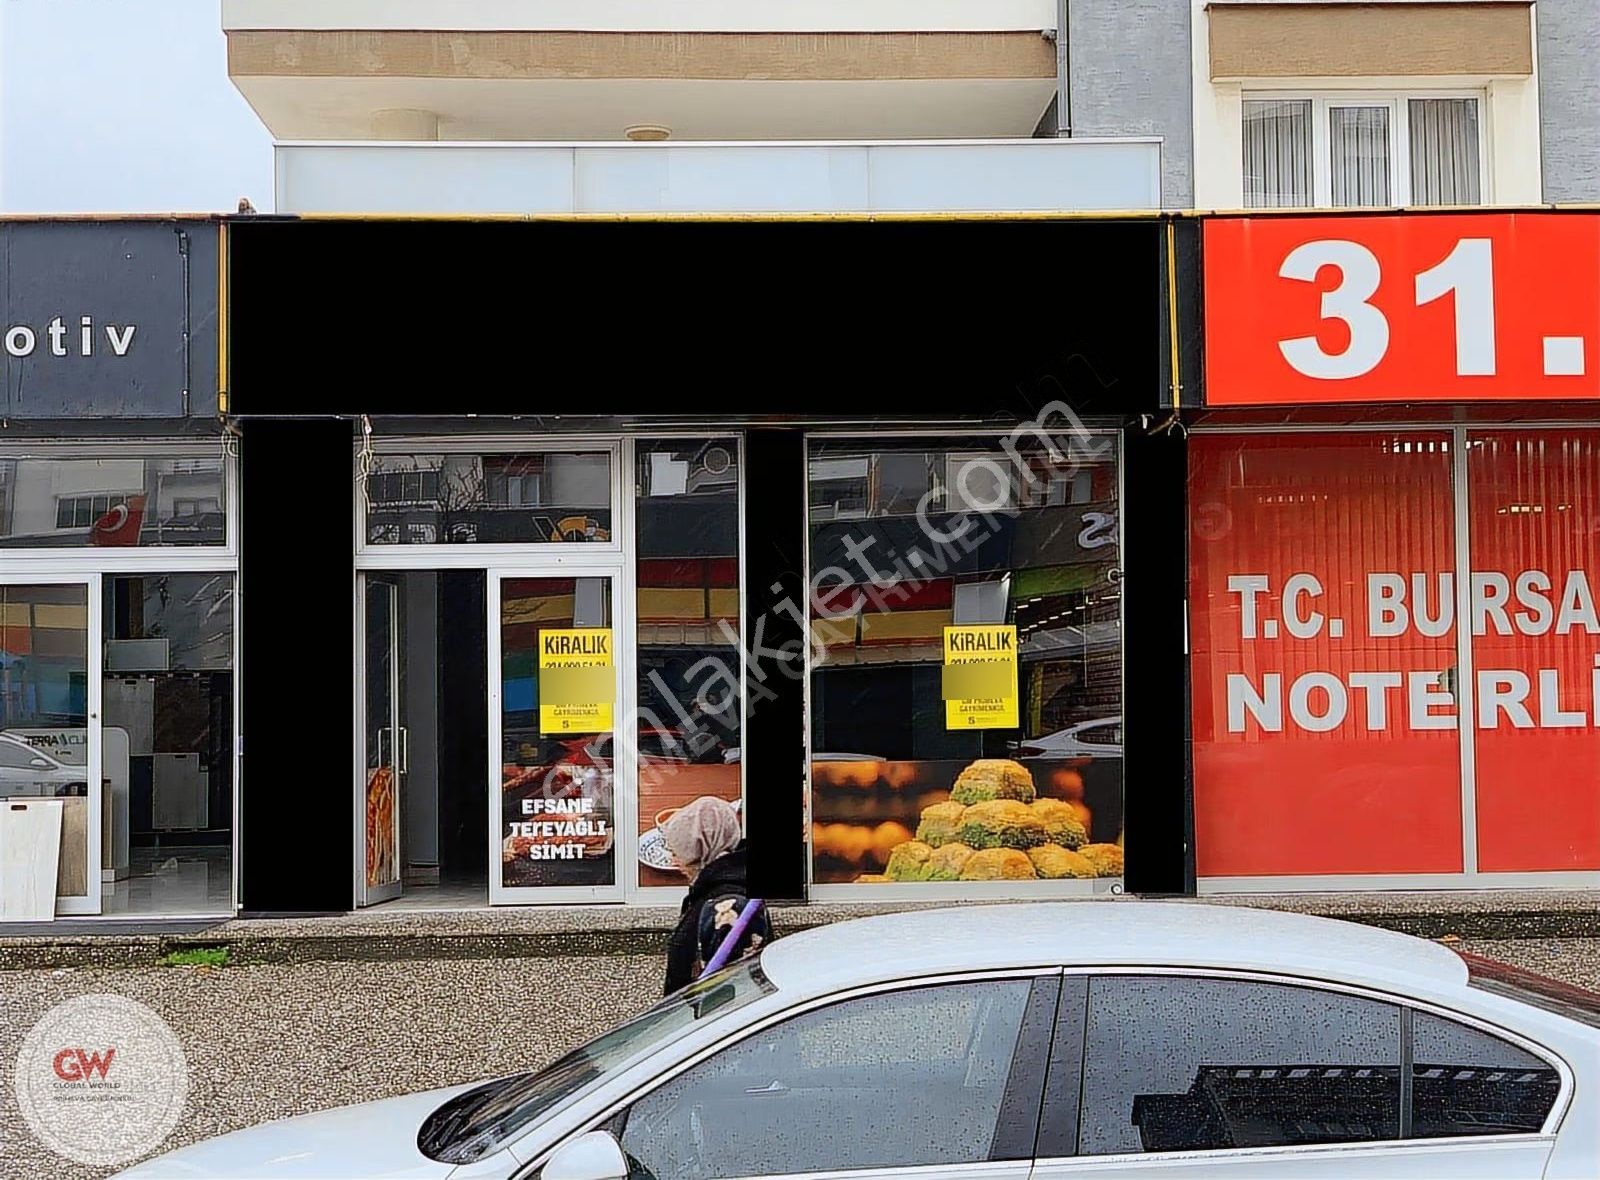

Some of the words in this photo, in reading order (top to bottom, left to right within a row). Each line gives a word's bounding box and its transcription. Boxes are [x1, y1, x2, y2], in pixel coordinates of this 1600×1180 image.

[1277, 236, 1586, 380] 31.
[4, 315, 137, 357] otiv
[1227, 572, 1343, 640] T.C.
[1367, 569, 1600, 639] BURSA
[521, 798, 593, 815] EFSANE
[529, 840, 586, 860] SİMİT
